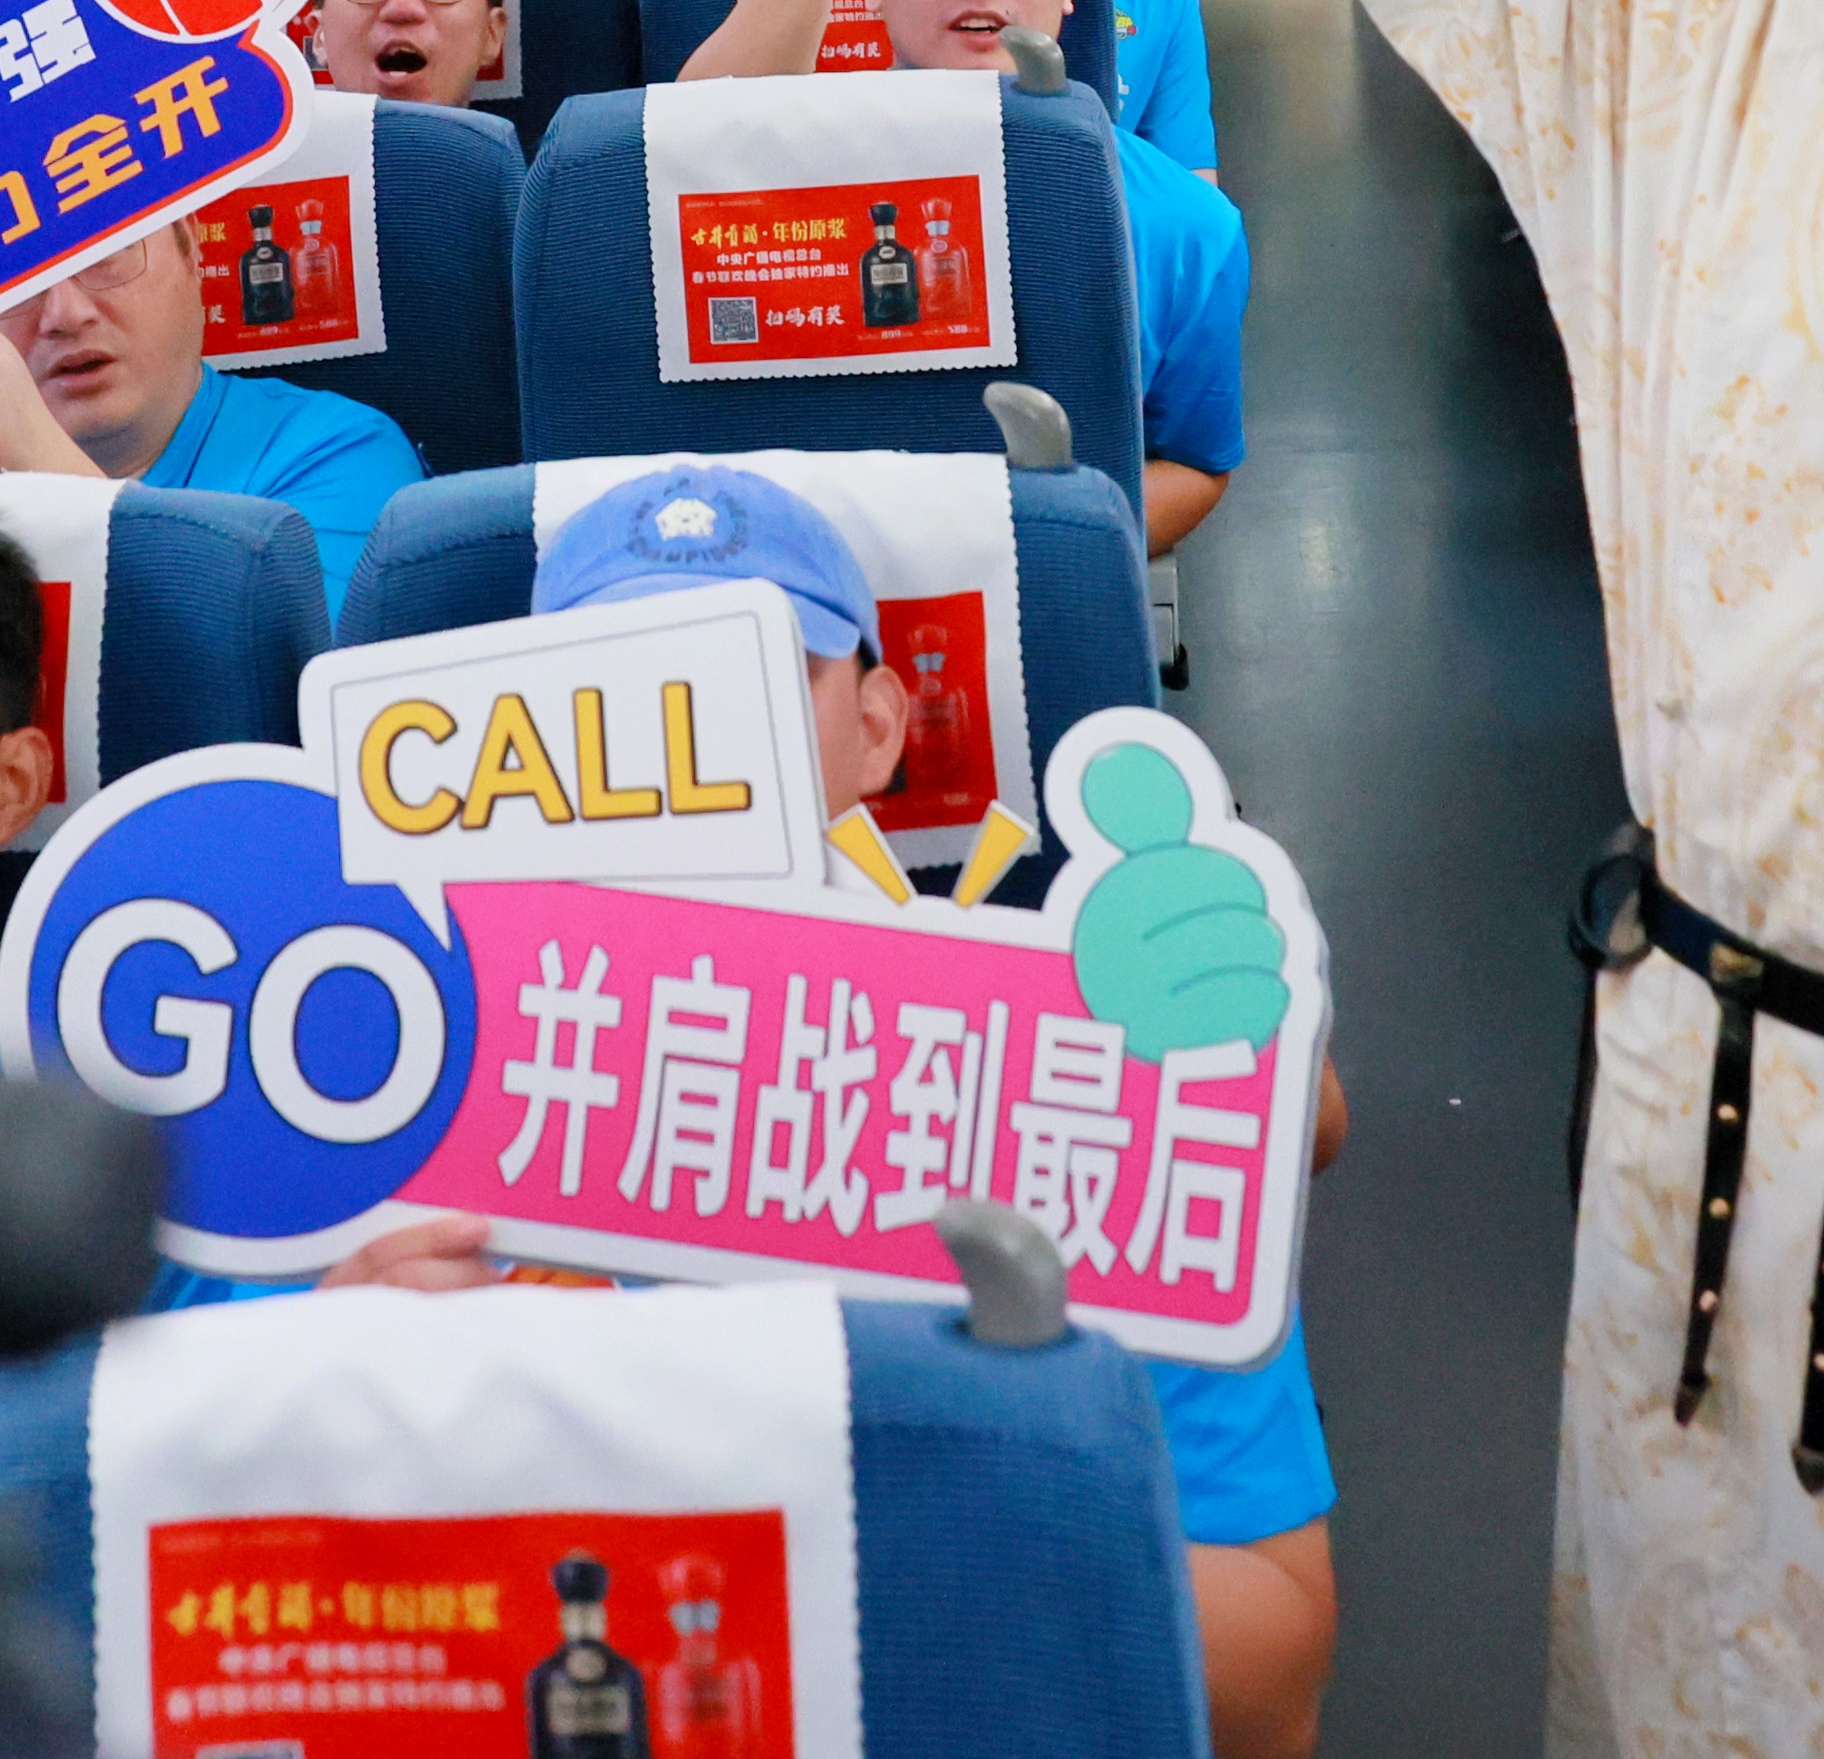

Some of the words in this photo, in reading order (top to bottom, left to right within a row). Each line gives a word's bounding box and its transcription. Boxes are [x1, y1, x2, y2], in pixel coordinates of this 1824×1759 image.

[359, 681, 752, 837] CALL
[57, 896, 447, 1147] GO
[496, 940, 1262, 1294] 并肩战到最后
